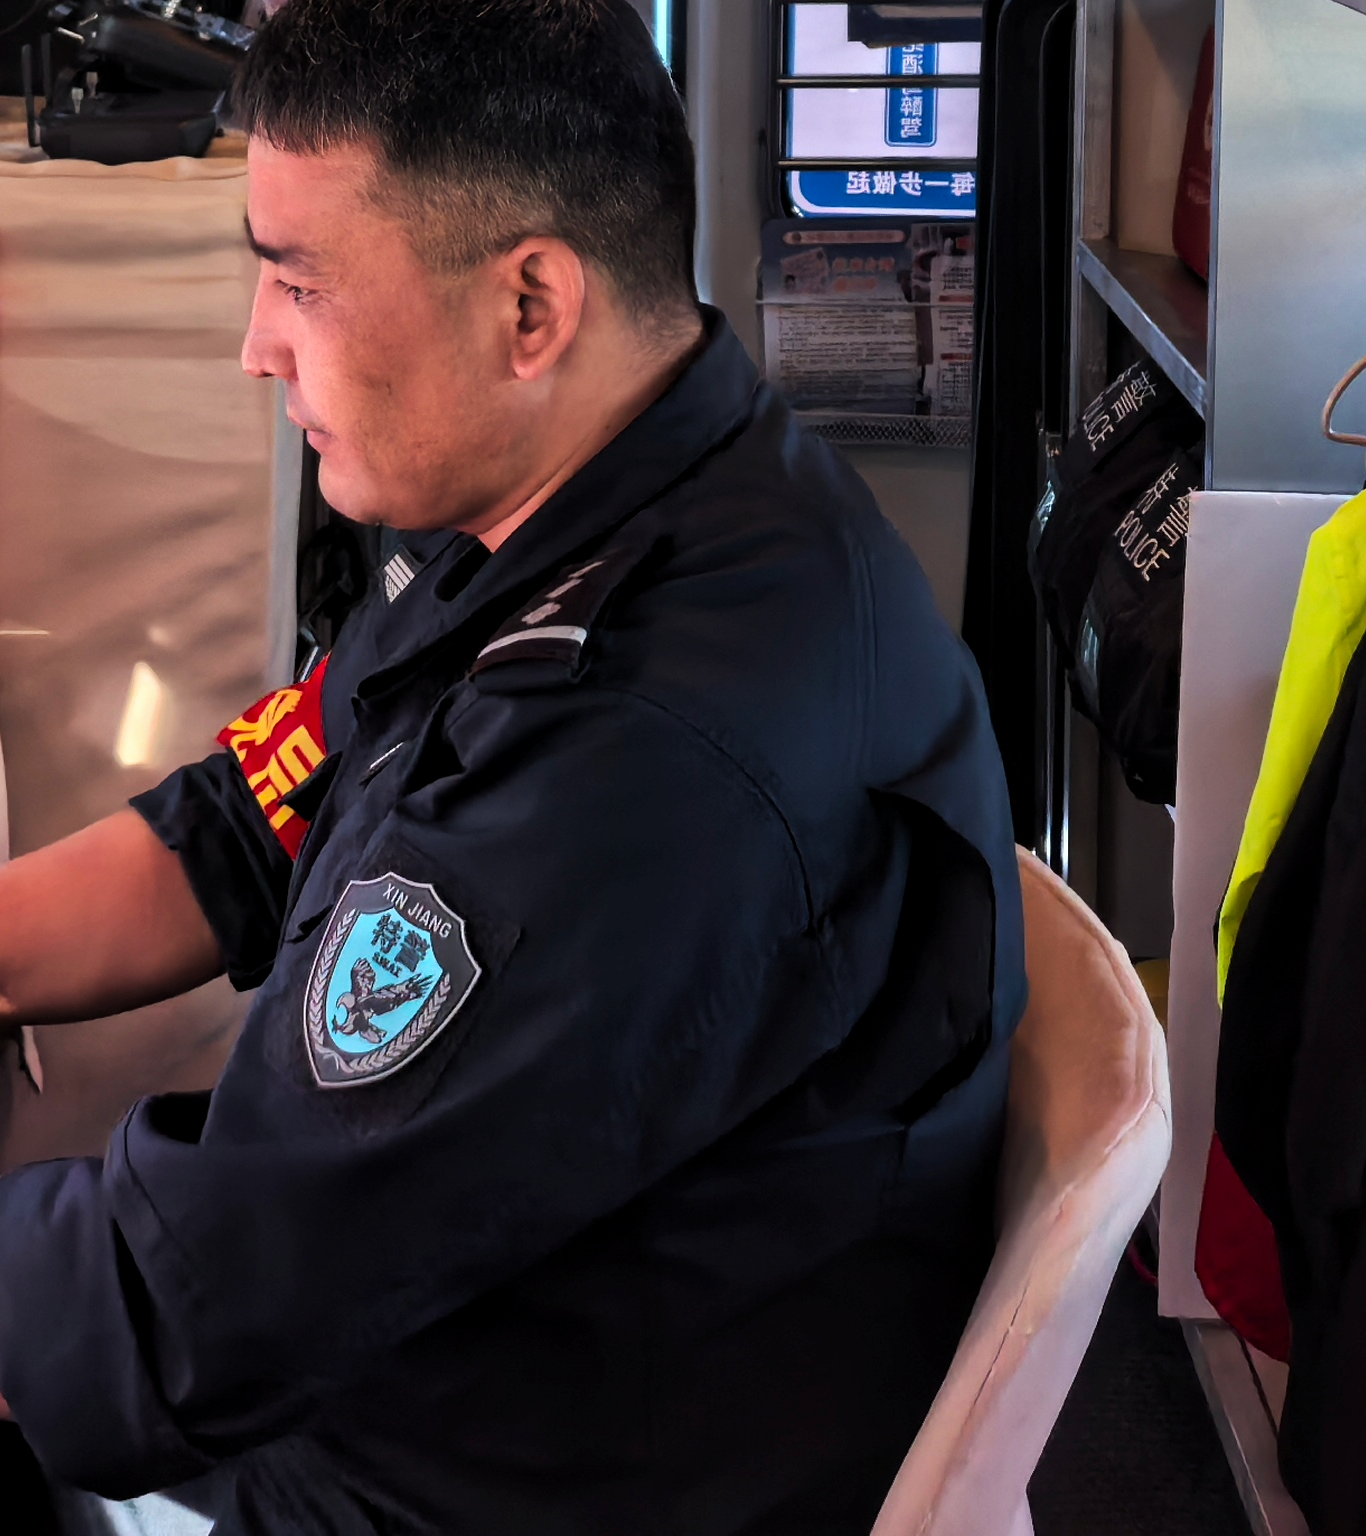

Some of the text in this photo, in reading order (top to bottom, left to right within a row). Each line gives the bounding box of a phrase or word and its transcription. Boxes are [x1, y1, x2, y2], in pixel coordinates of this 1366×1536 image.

[1114, 509, 1171, 582] POLICE
[382, 882, 453, 939] XIN JIANG
